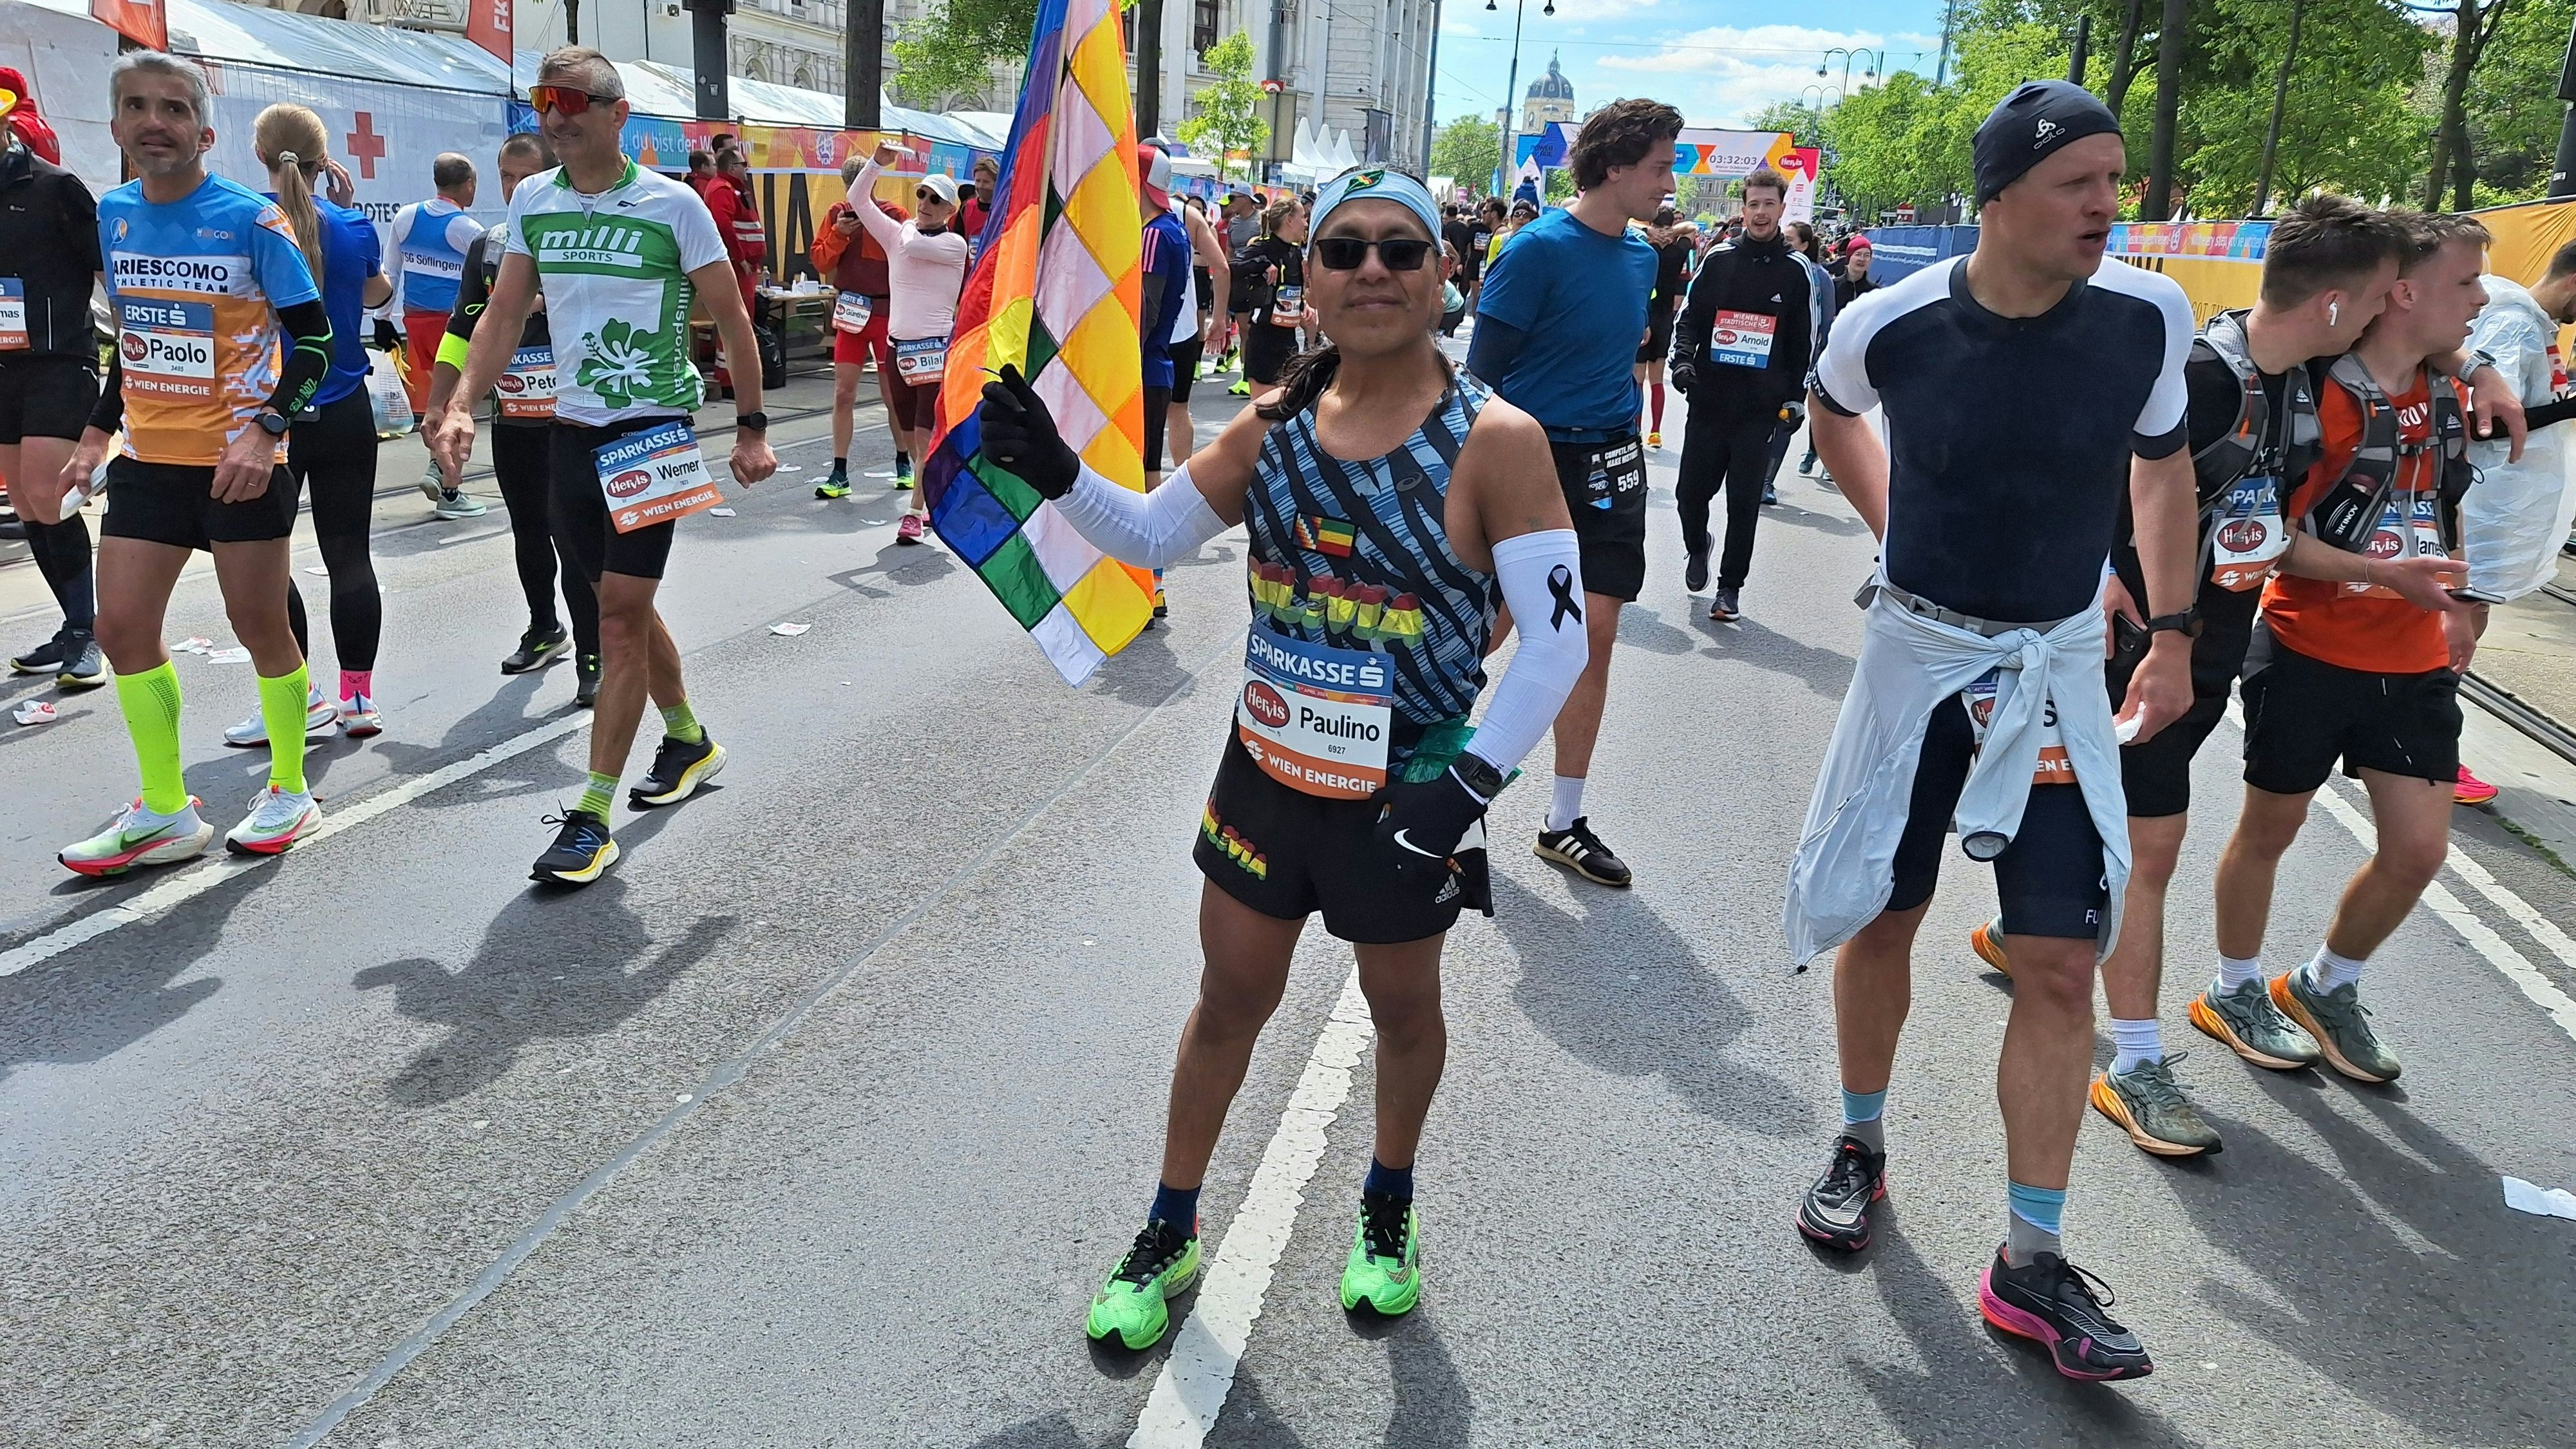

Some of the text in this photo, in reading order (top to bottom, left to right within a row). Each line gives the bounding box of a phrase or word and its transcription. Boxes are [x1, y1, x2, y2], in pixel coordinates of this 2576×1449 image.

[632, 131, 648, 150] du
[652, 133, 675, 153] bist
[677, 135, 697, 154] der
[2034, 128, 2065, 149] odlo
[919, 152, 929, 167] you
[931, 155, 942, 167] are
[943, 153, 965, 170] insane!
[1710, 155, 1757, 166] 03:32:03
[1780, 157, 1803, 167] Hervis
[541, 225, 643, 252] milli
[416, 254, 462, 272] Söflingen
[562, 251, 613, 261] SPORTS
[114, 258, 229, 282] ARIESCOMO
[184, 280, 229, 294] TEAM
[840, 292, 857, 304] ERSTE
[125, 304, 168, 324] ERSTE
[846, 308, 868, 321] Günther
[1733, 312, 1759, 321] WIENER
[896, 342, 934, 353] SPARKASSE
[1716, 332, 1769, 346] Hervis Arnold
[150, 339, 207, 364] Paolo
[1719, 353, 1747, 365] ERSTE
[920, 355, 943, 366] Bilal
[134, 379, 211, 396] WIEN ENERGIE
[519, 403, 538, 412] WIEN
[600, 430, 679, 468] SPARKASSE
[1606, 458, 1622, 469] MAKE
[611, 460, 699, 495] Hervis Werner
[1617, 469, 1639, 493] 559
[642, 489, 715, 518] WIEN ENERGIE
[1250, 634, 1356, 686] SPARKASSE
[1304, 688, 1317, 696] APRIL
[1247, 685, 1380, 742] Hervis Paulino
[1328, 744, 1346, 755] 6927
[1267, 752, 1377, 794] WIEN ENERGIE
[1435, 885, 1461, 904] adidas
